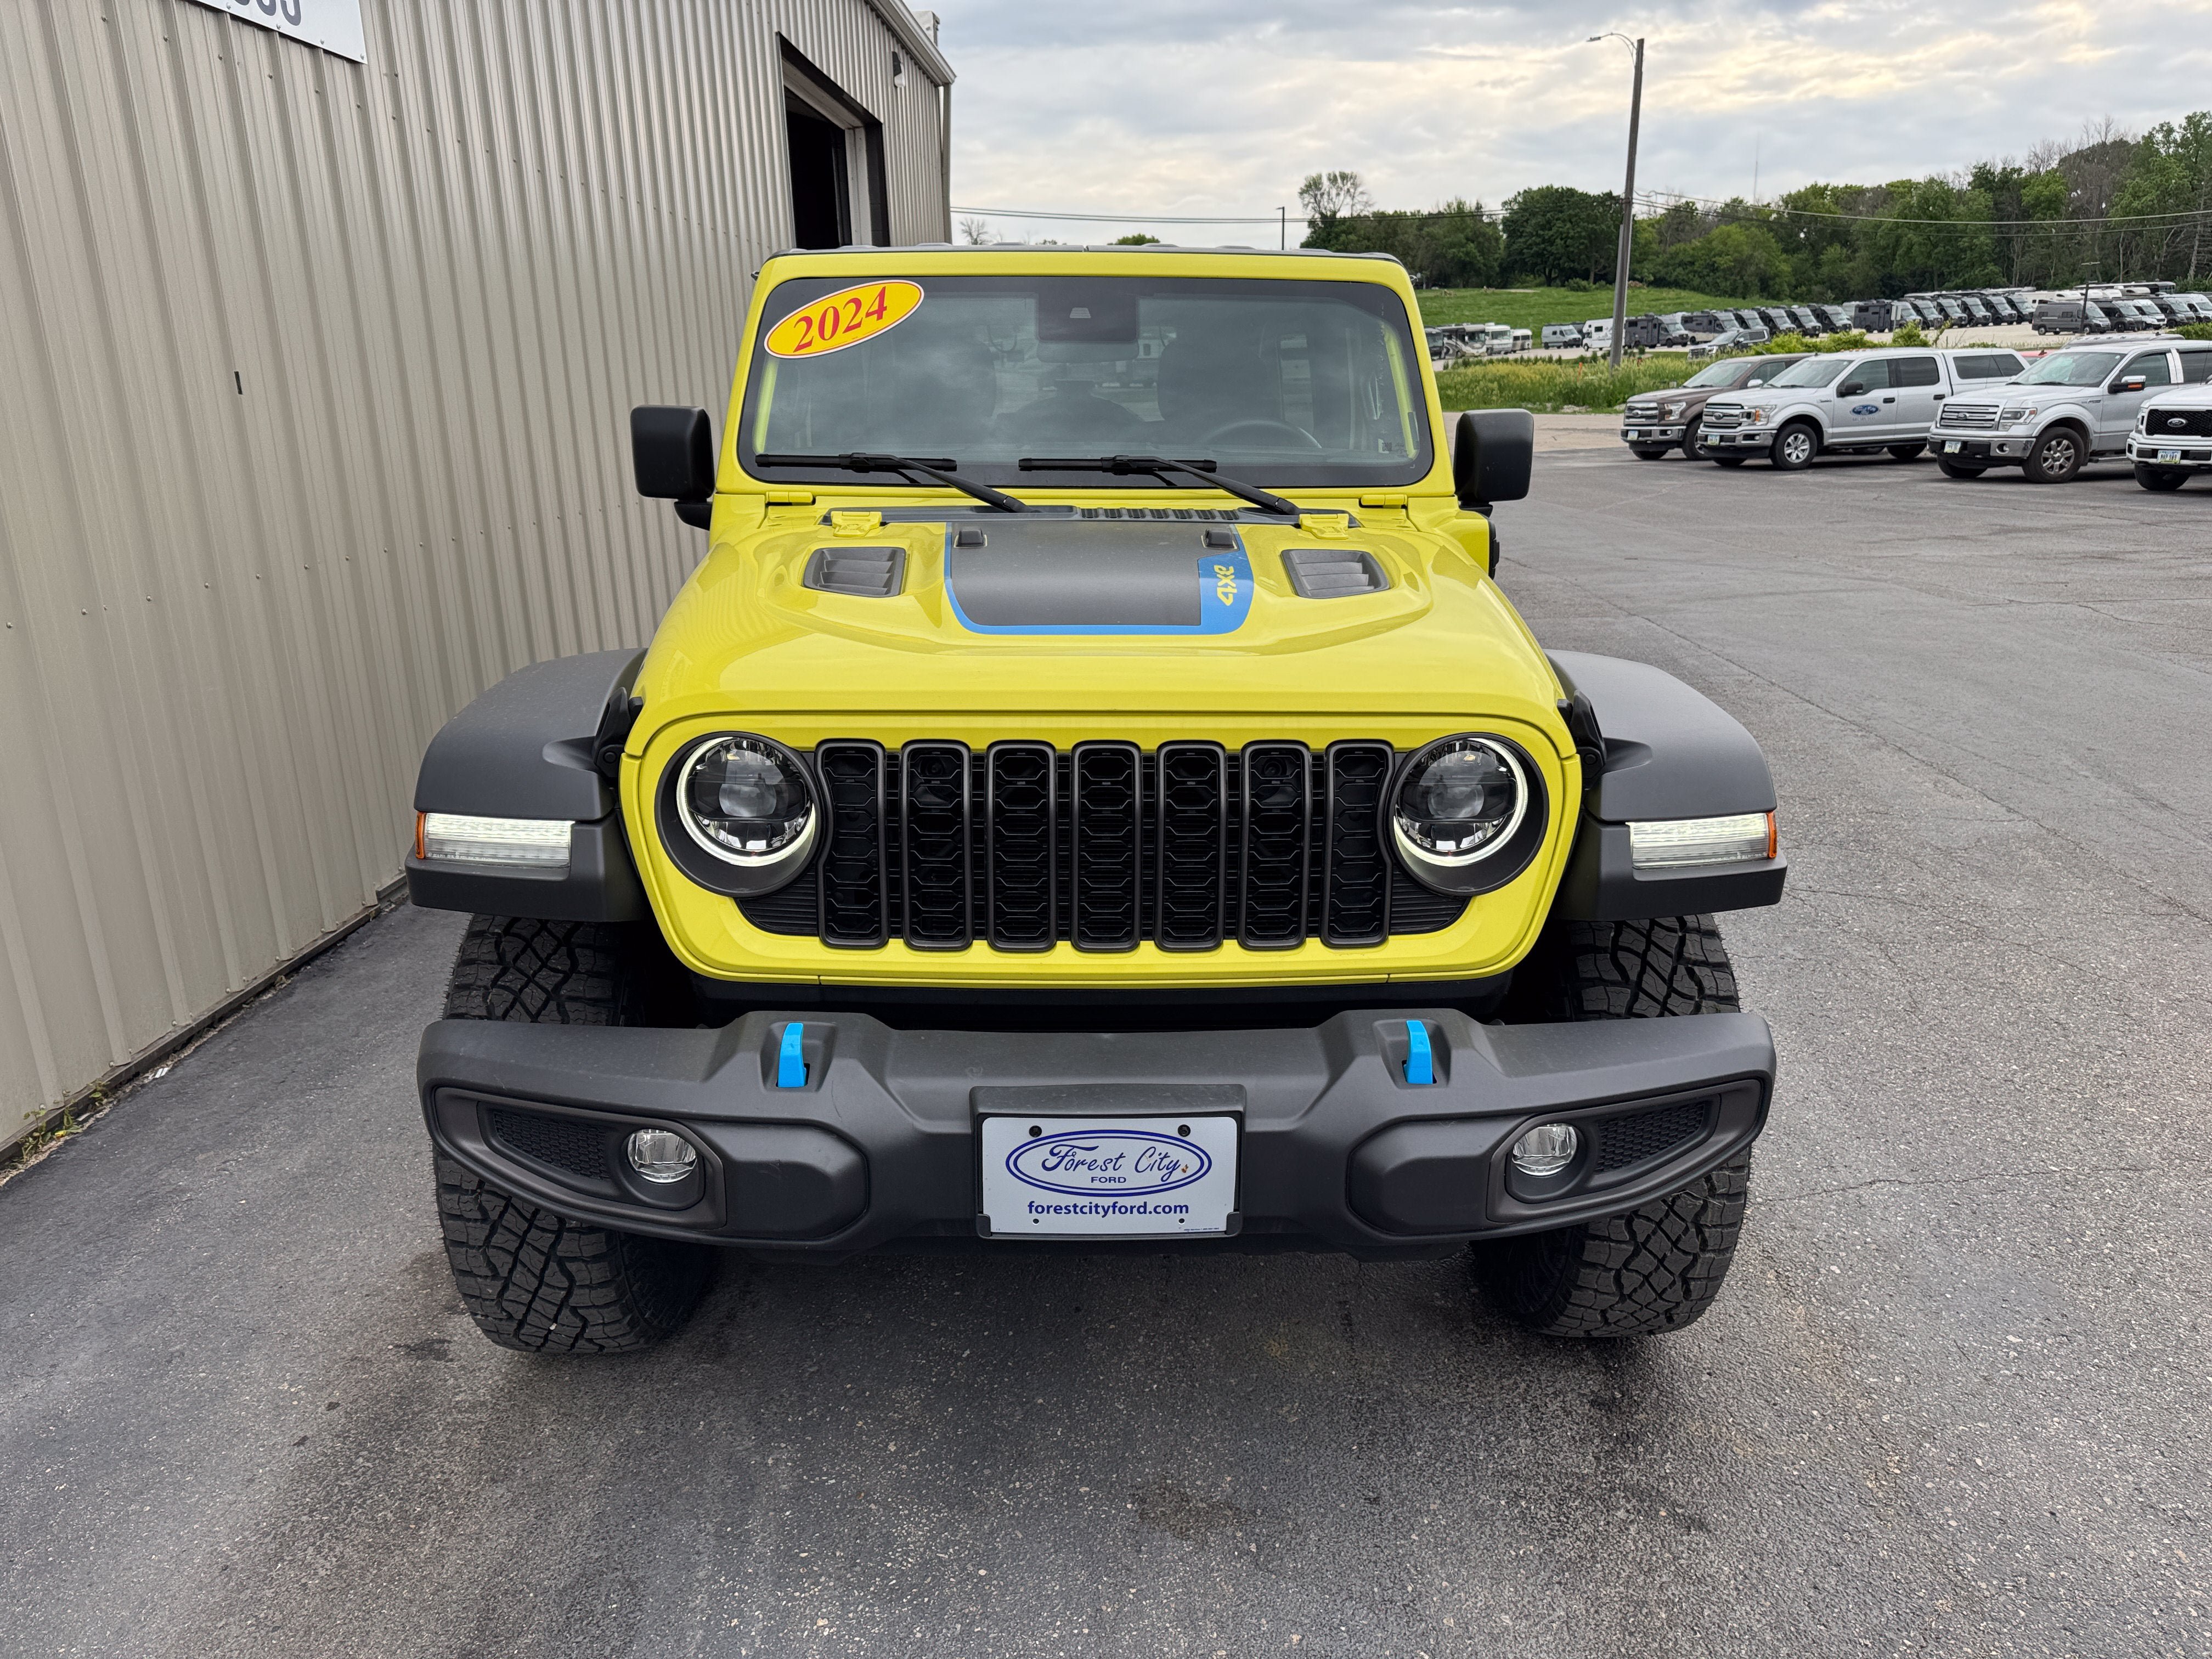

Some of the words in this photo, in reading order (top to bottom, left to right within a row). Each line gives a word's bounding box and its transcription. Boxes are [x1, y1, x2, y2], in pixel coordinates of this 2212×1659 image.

[793, 286, 887, 353] 2024
[1214, 565, 1237, 606] 4xe
[1042, 1144, 1126, 1171] Forest
[1135, 1146, 1181, 1182] City
[1028, 1201, 1189, 1218] forestcityford.com
